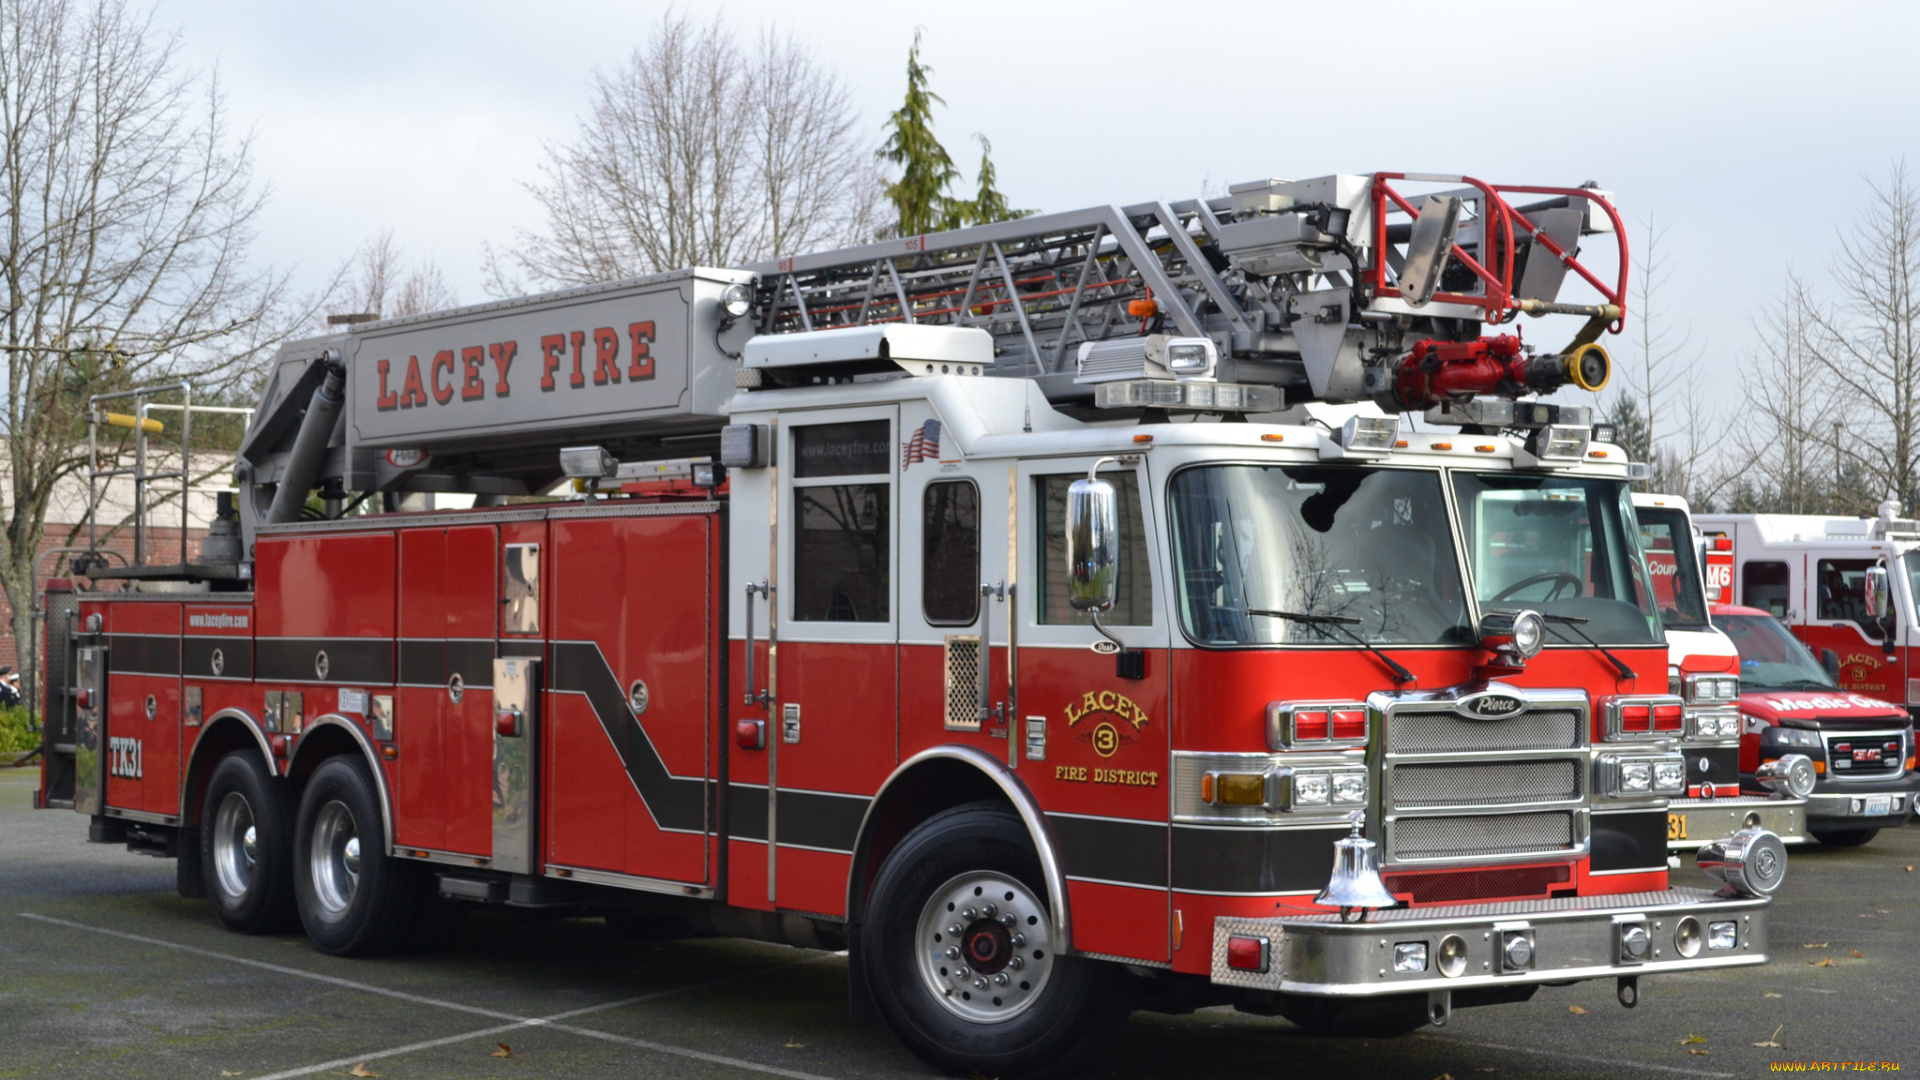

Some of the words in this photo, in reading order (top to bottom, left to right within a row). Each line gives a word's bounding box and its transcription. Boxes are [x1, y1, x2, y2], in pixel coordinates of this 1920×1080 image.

[905, 240, 918, 250] 105
[778, 260, 787, 271] 95
[377, 340, 518, 412] LACEY
[540, 320, 656, 392] FIRE
[1706, 566, 1731, 587] M6
[190, 613, 249, 629] www.laceyfire.com
[1838, 653, 1882, 669] LACEY
[1852, 684, 1886, 692] DISTRICT
[1064, 690, 1149, 731] LACEY
[1476, 696, 1515, 714] Pierce
[1766, 698, 1851, 711] Medic
[1097, 729, 1114, 750] 3
[110, 736, 142, 780] TK31
[1853, 748, 1881, 761] GMC
[1055, 766, 1088, 782] FIRE
[1093, 769, 1159, 787] DISTRICT
[1667, 813, 1687, 840] 31
